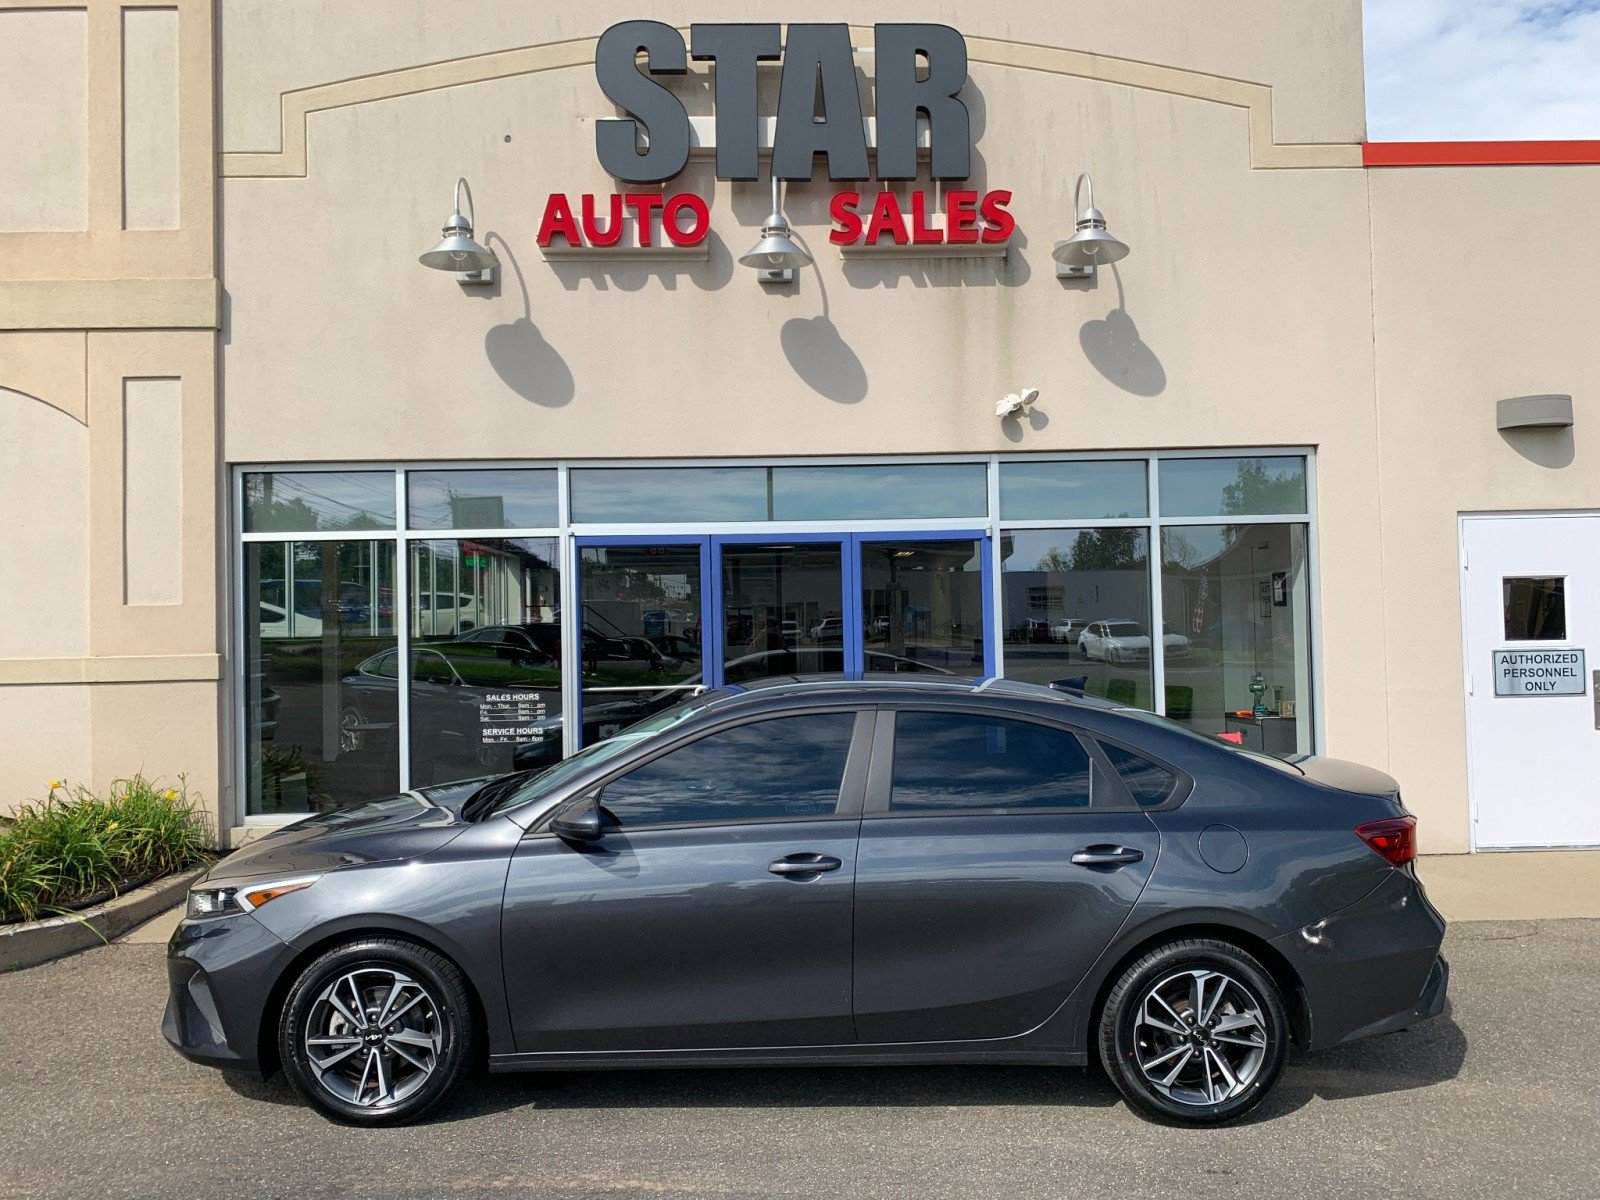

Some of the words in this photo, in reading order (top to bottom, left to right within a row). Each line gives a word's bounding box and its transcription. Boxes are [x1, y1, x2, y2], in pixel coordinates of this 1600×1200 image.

[596, 20, 970, 184] STAR
[536, 193, 710, 248] AUTO
[829, 190, 1015, 246] SALES
[1501, 654, 1578, 665] AUTHORIZED
[1504, 668, 1577, 678] PERSONNEL
[1525, 681, 1556, 691] ONLY
